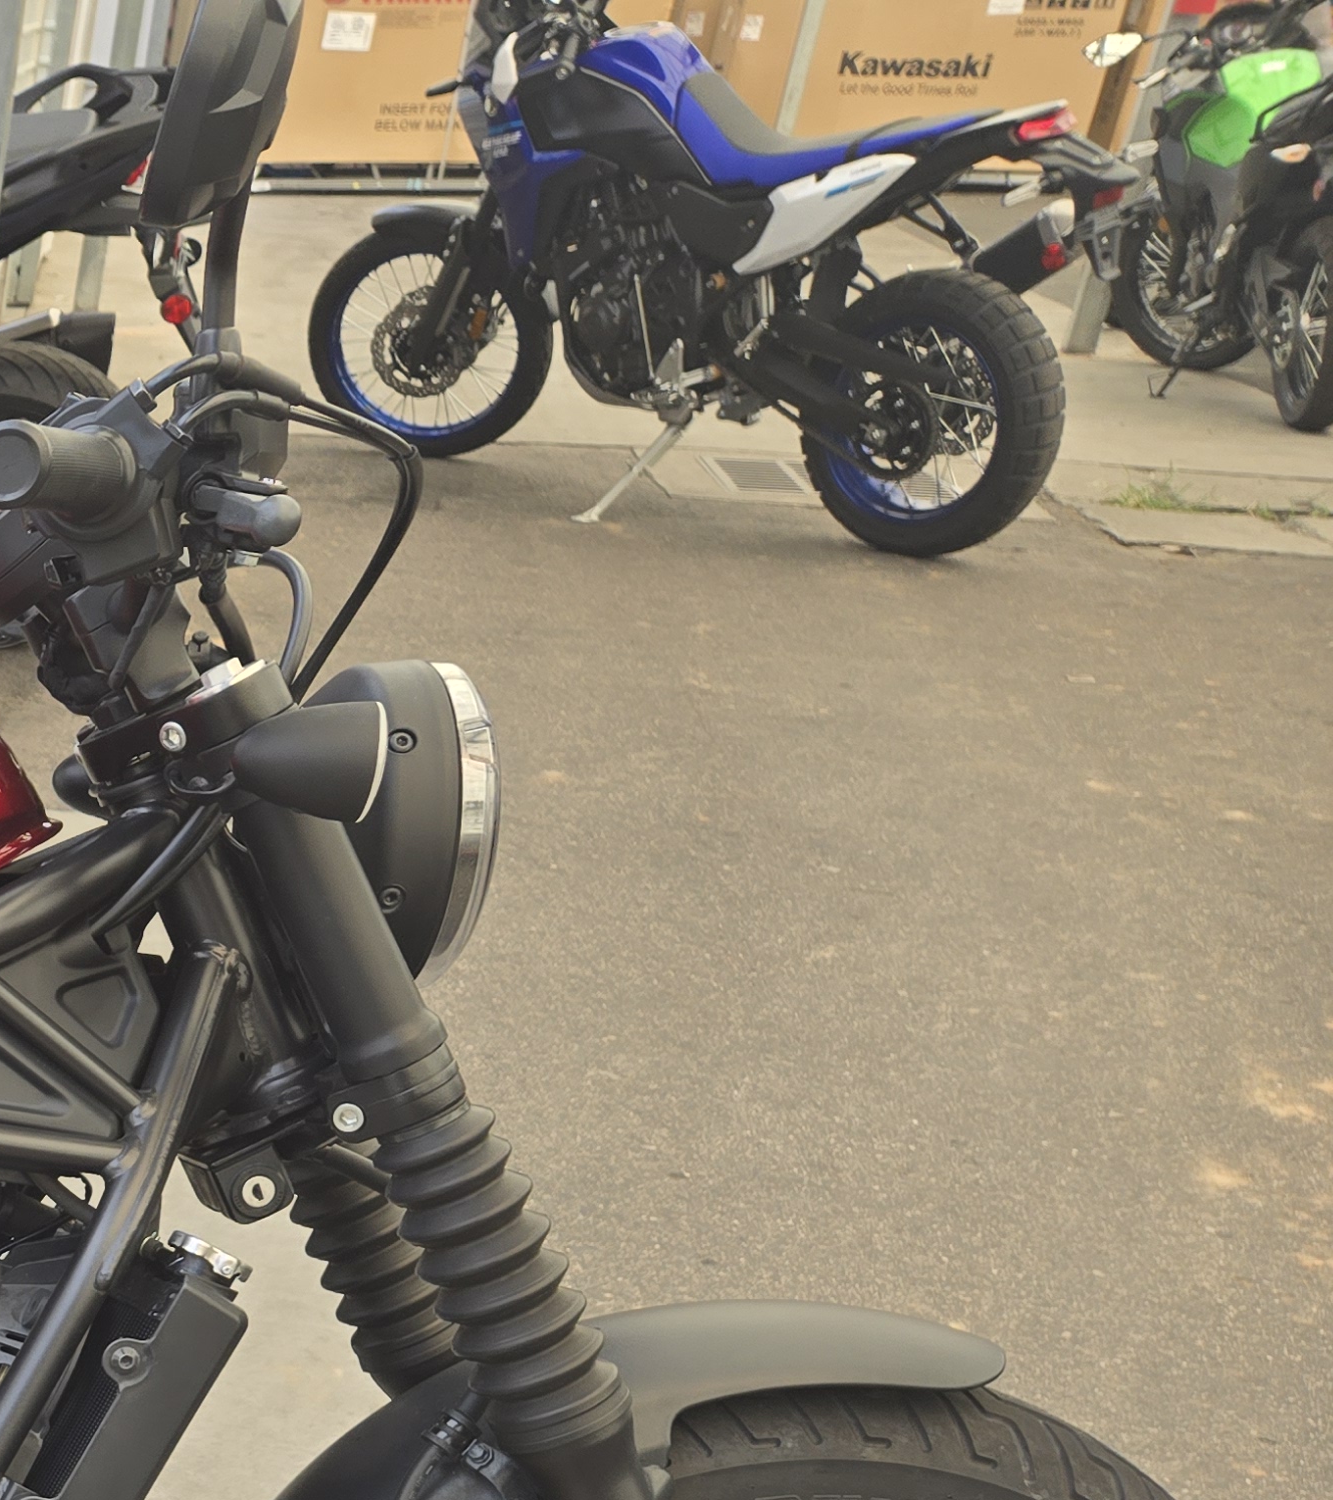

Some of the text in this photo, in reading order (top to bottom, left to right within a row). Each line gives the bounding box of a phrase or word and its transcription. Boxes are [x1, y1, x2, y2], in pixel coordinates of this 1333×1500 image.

[837, 50, 993, 78] Kawasaki
[882, 82, 914, 96] Good
[917, 83, 952, 97] Times
[379, 102, 426, 116] INSERT
[374, 118, 421, 132] BELOW
